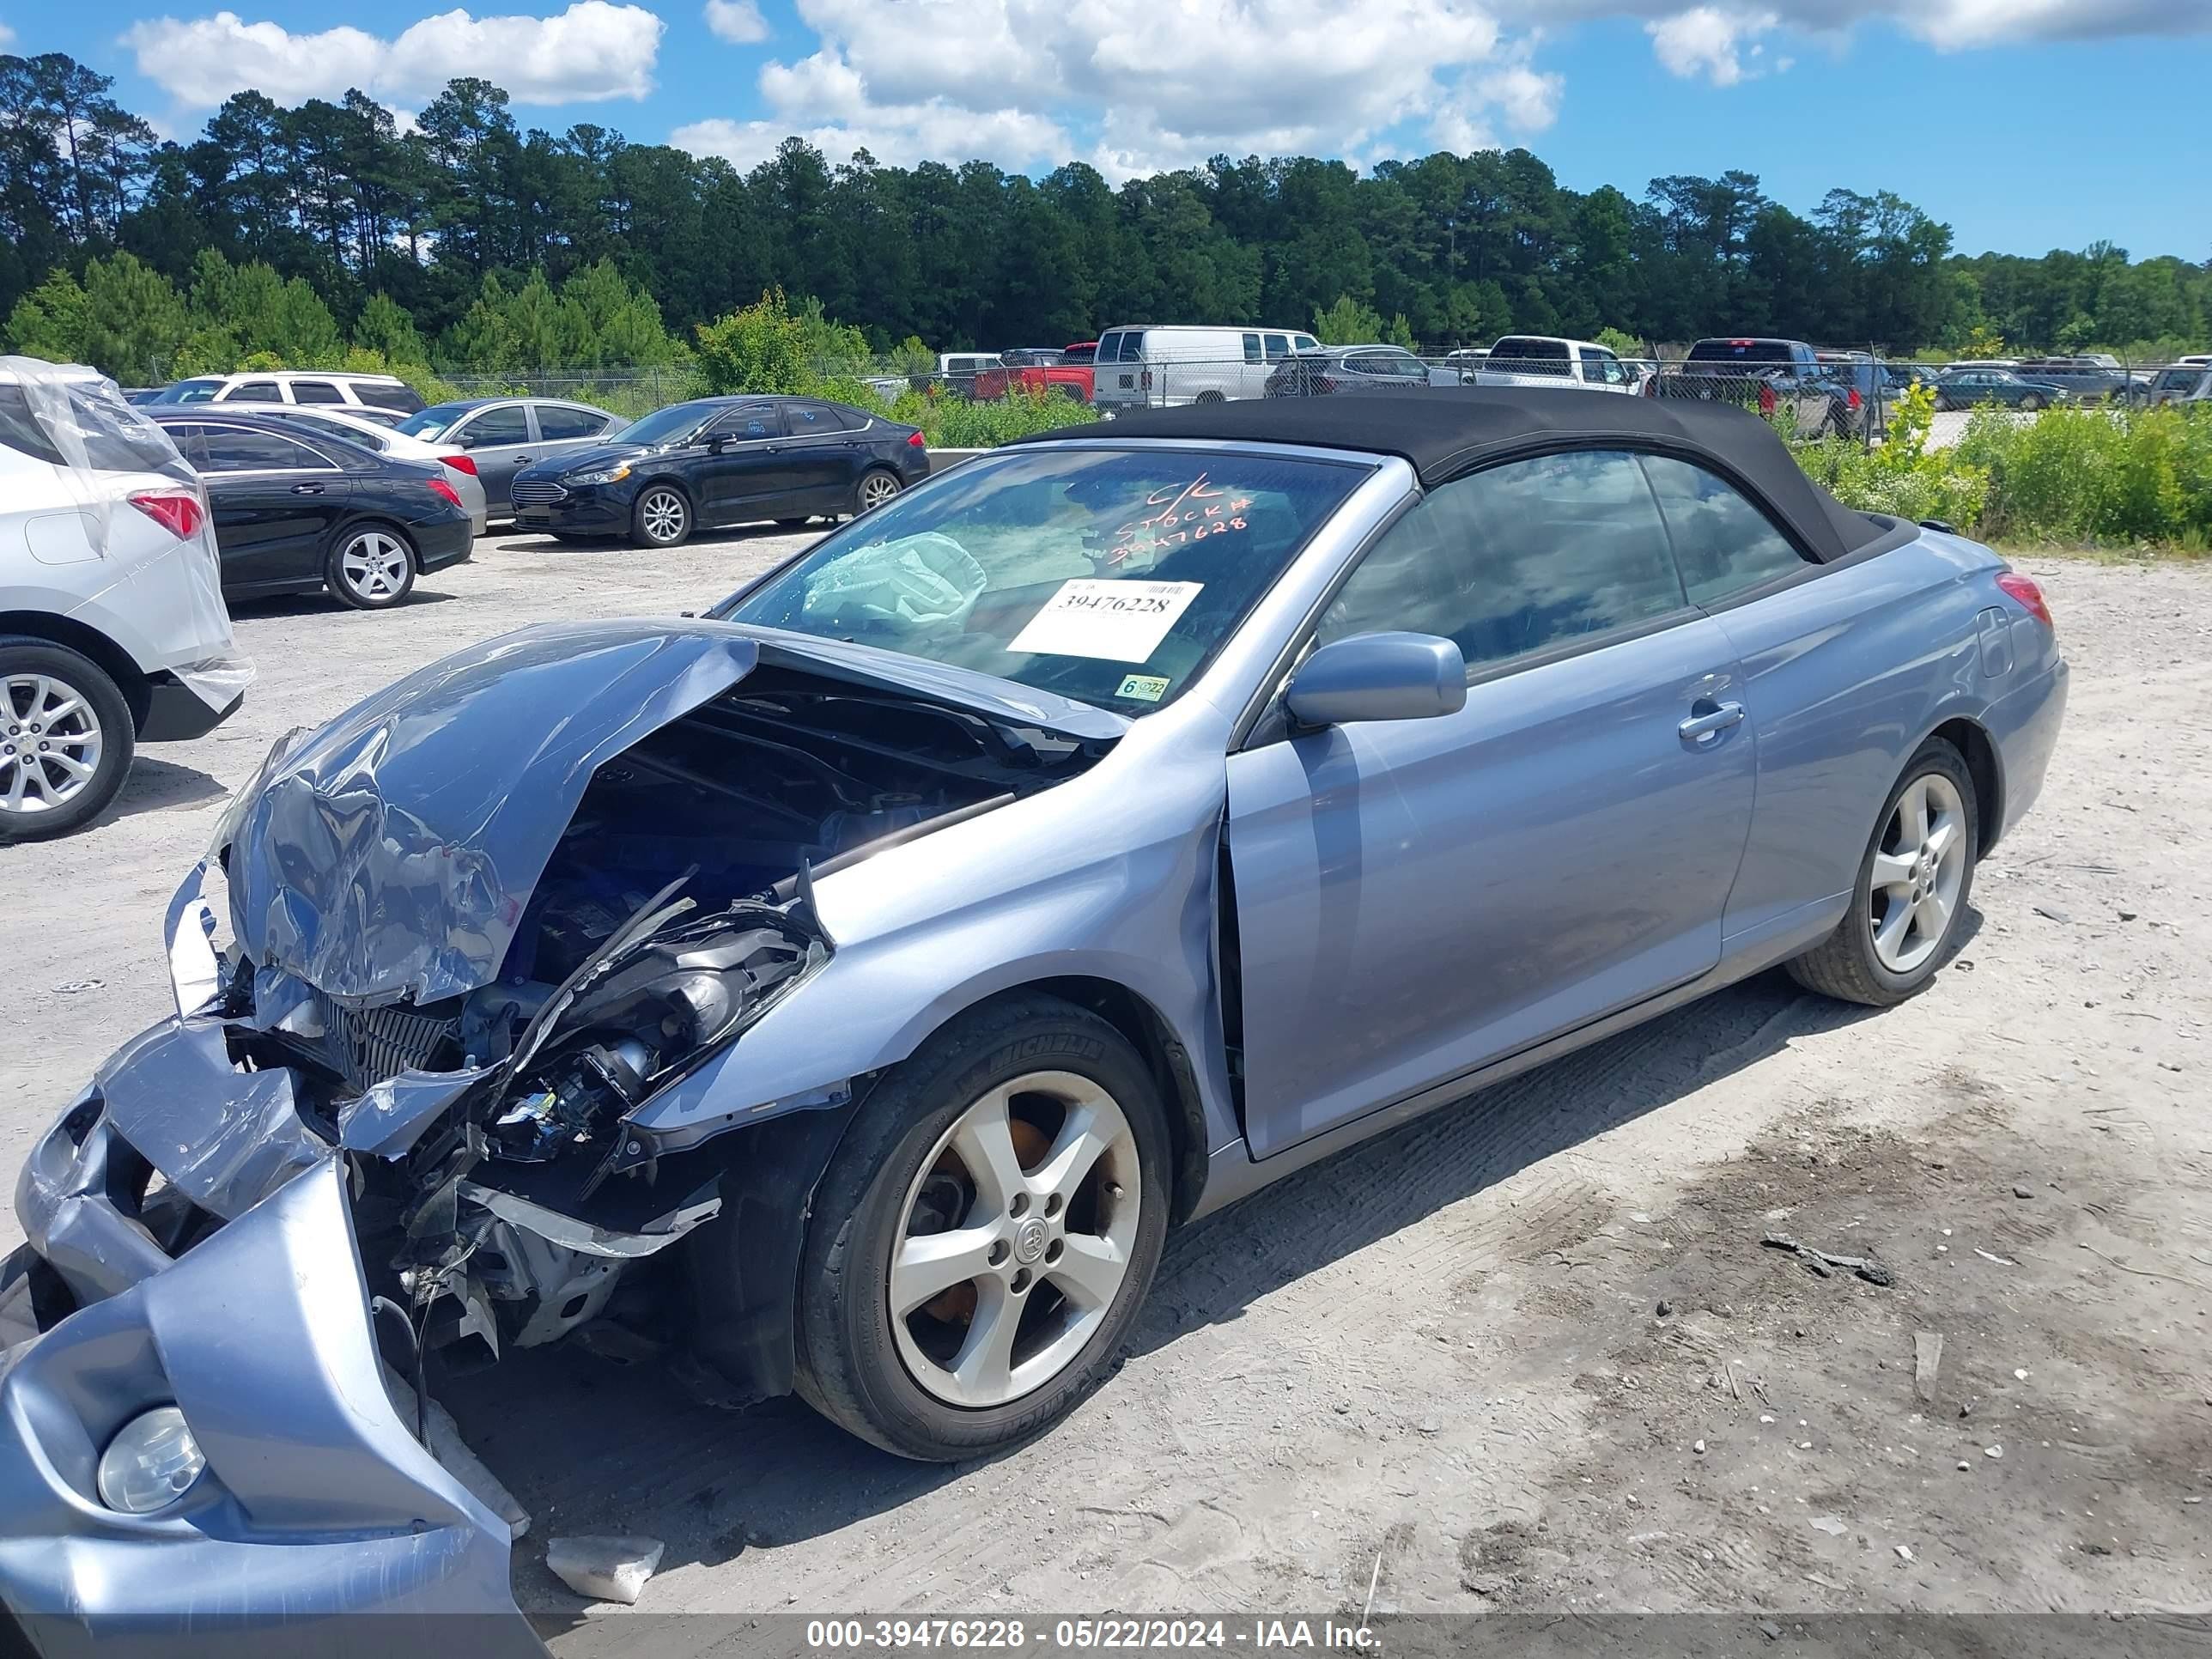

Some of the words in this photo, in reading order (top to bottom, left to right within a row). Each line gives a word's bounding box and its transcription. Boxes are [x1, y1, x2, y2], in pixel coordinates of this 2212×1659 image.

[1058, 595, 1170, 613] 39476228
[1123, 679, 1138, 694] 6
[991, 1034, 1107, 1078] MICHELIN
